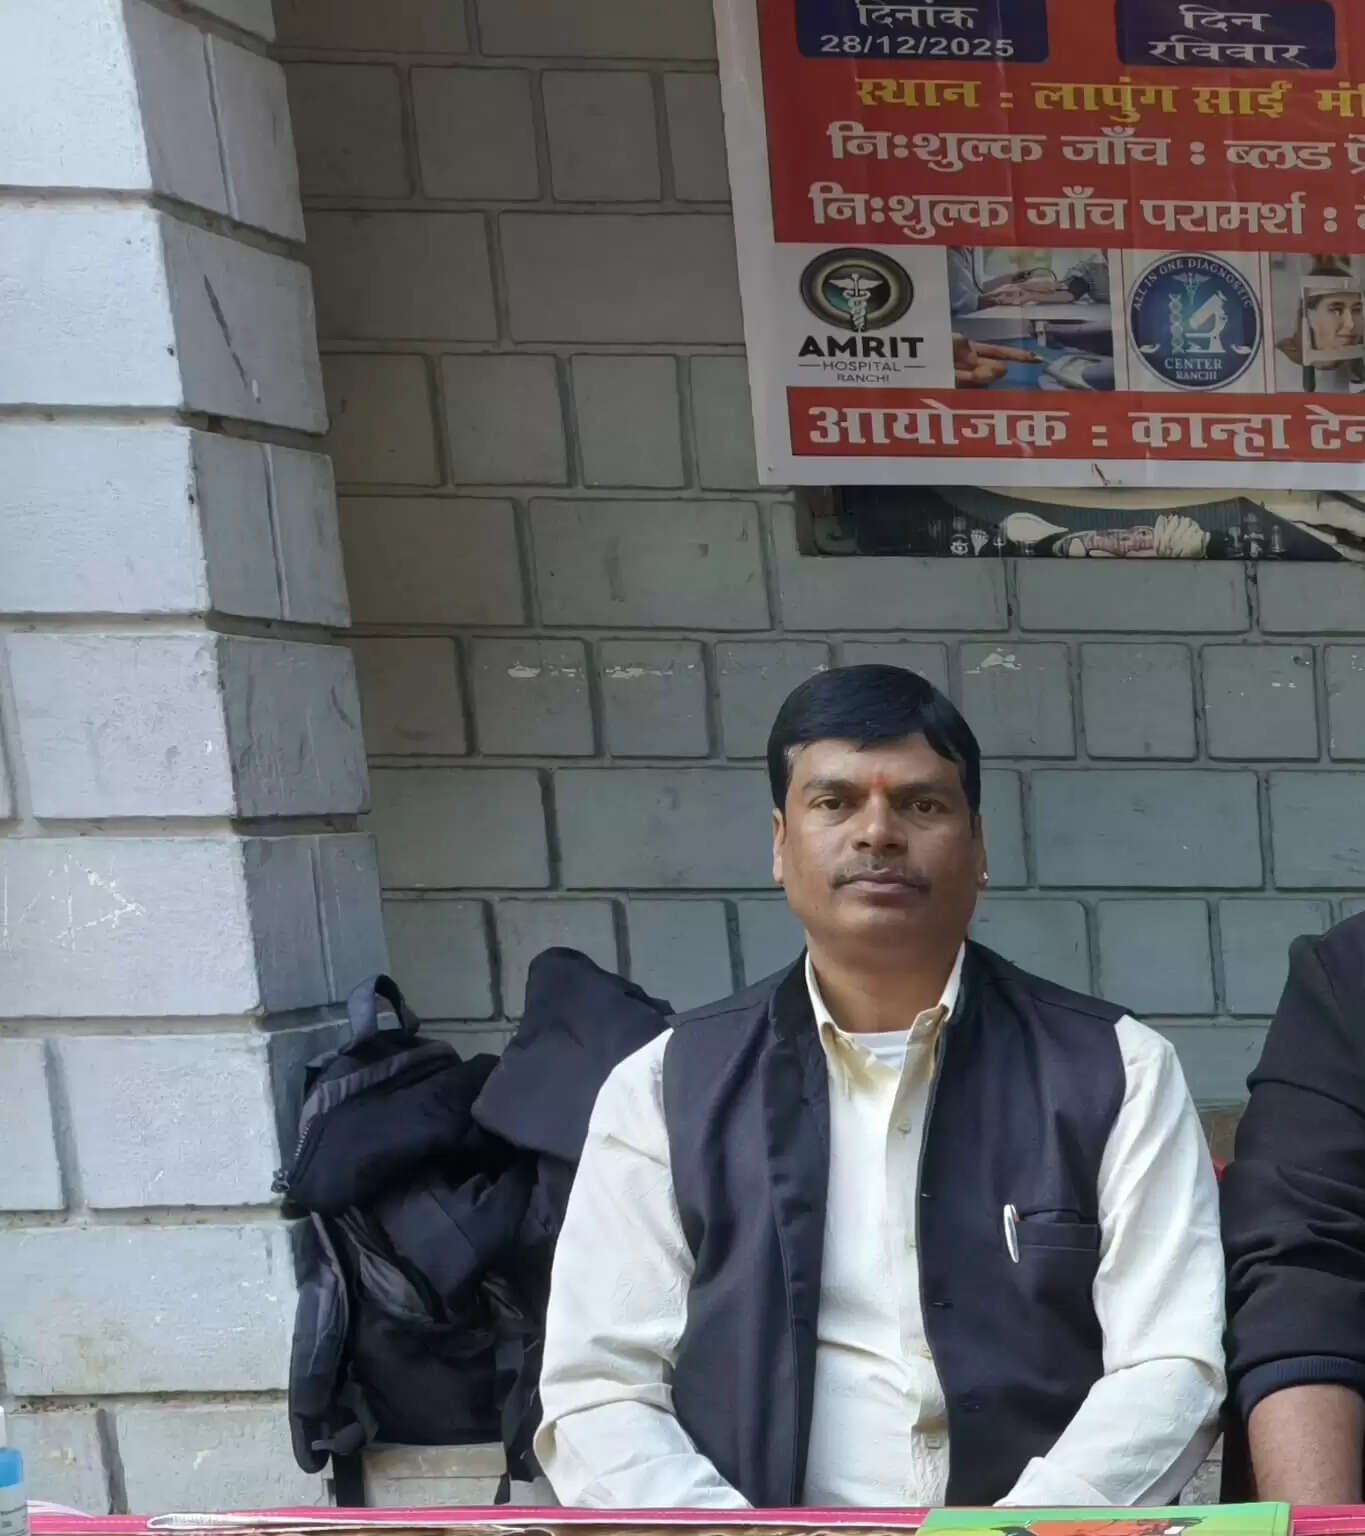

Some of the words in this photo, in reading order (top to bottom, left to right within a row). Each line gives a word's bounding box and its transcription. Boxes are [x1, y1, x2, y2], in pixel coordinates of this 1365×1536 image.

[857, 0, 979, 28] दिनांक
[1180, 3, 1271, 33] दिन
[820, 35, 1014, 56] 28/12/2025
[1148, 39, 1311, 67] रविवार
[855, 78, 981, 108] स्थान
[1031, 77, 1178, 122] लापुंग
[827, 121, 1047, 172] निःशुल्क
[1061, 126, 1171, 166] जाँच
[1224, 139, 1335, 171] ब्लड
[808, 181, 1012, 238] निःशुल्क
[1025, 186, 1128, 230] जाँच
[1140, 192, 1306, 234] परामर्श
[1159, 259, 1185, 275] ONE
[798, 335, 924, 359] AMRIT
[822, 361, 901, 372] HOSPITAL
[1165, 358, 1222, 369] CENTER
[836, 373, 889, 383] RANCHI
[808, 398, 1070, 446] आयोजक
[1128, 410, 1292, 458] कान्हा
